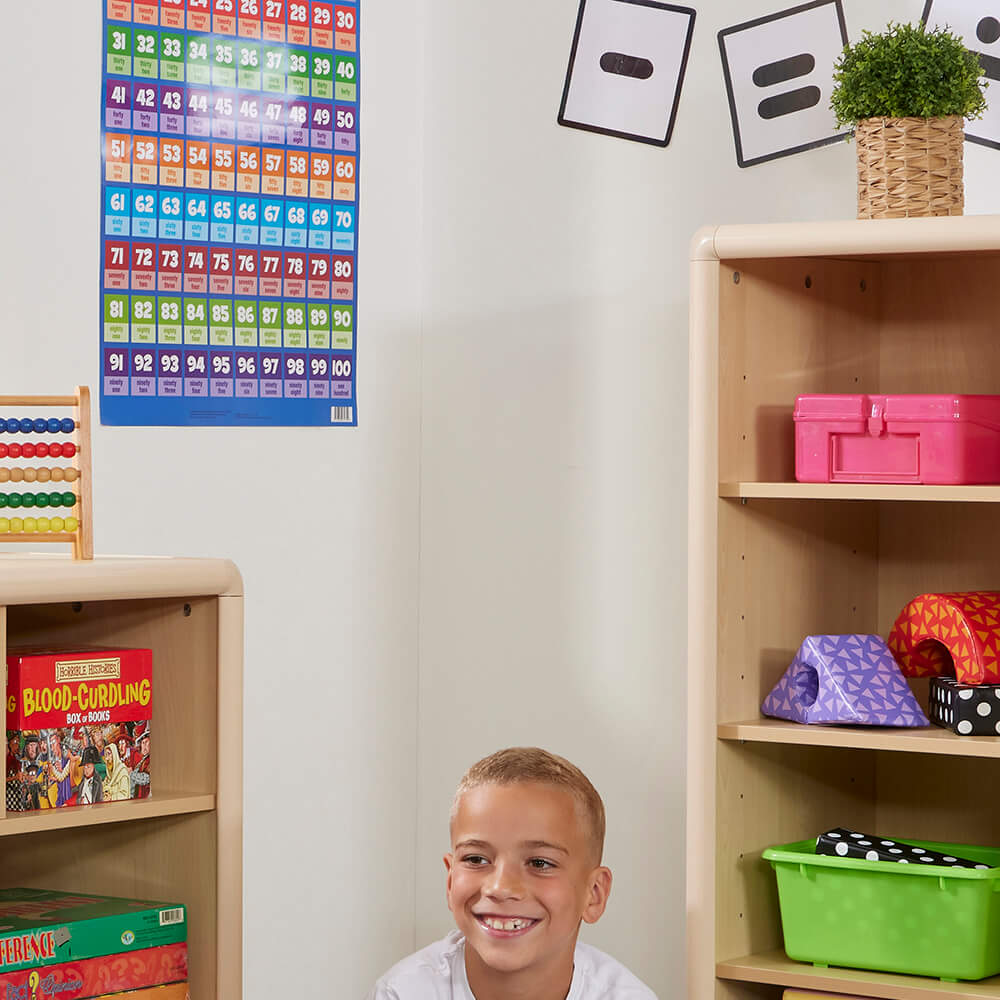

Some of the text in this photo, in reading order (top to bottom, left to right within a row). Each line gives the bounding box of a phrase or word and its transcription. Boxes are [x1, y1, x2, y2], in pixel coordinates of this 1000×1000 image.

[241, 0, 257, 15] 26
[266, 0, 281, 18] 27
[291, 4, 306, 22] 28
[314, 8, 330, 25] 29
[337, 11, 353, 29] 30
[113, 32, 354, 79] 31 32 33 34 35 36 37 38 39 40
[112, 87, 353, 129] 41 42 43 44 45 46 47 48 49 50
[112, 139, 353, 179] 51 52 53 54 55 56 57 58 59 60
[111, 194, 351, 228] 61 62 63 64 65 66 67 68 69 70
[111, 248, 351, 278] 71 72 73 74 75 76 77 78 79 80
[110, 301, 350, 327] 81 82 83 84 85 86 87 88 89 90
[110, 354, 350, 377] 91 92 93 94 95 96 97 98 99 100
[88, 663, 117, 676] HISTORIES
[23, 678, 151, 718] BLOOD-CURDLING
[66, 712, 81, 725] BOX
[88, 710, 111, 723] BOOKS
